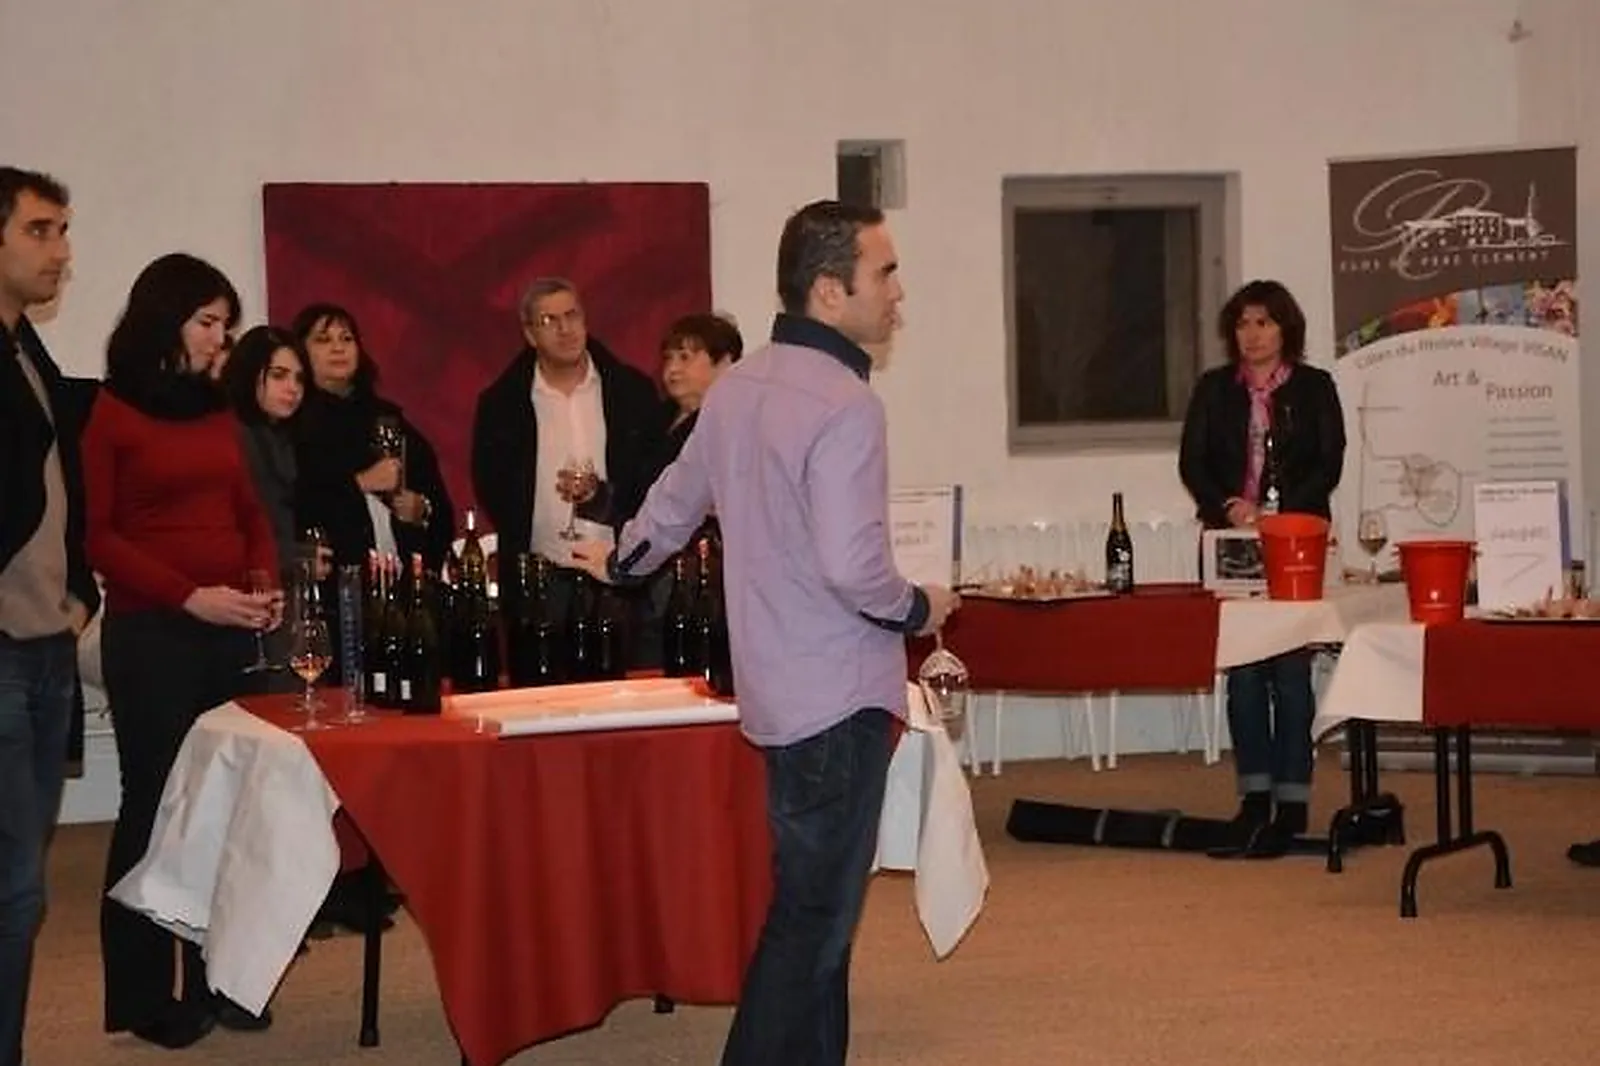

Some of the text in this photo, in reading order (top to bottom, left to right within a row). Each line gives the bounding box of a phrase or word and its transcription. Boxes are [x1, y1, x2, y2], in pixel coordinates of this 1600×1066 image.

[1433, 368, 1480, 386] Art &
[1485, 381, 1553, 401] Passion
